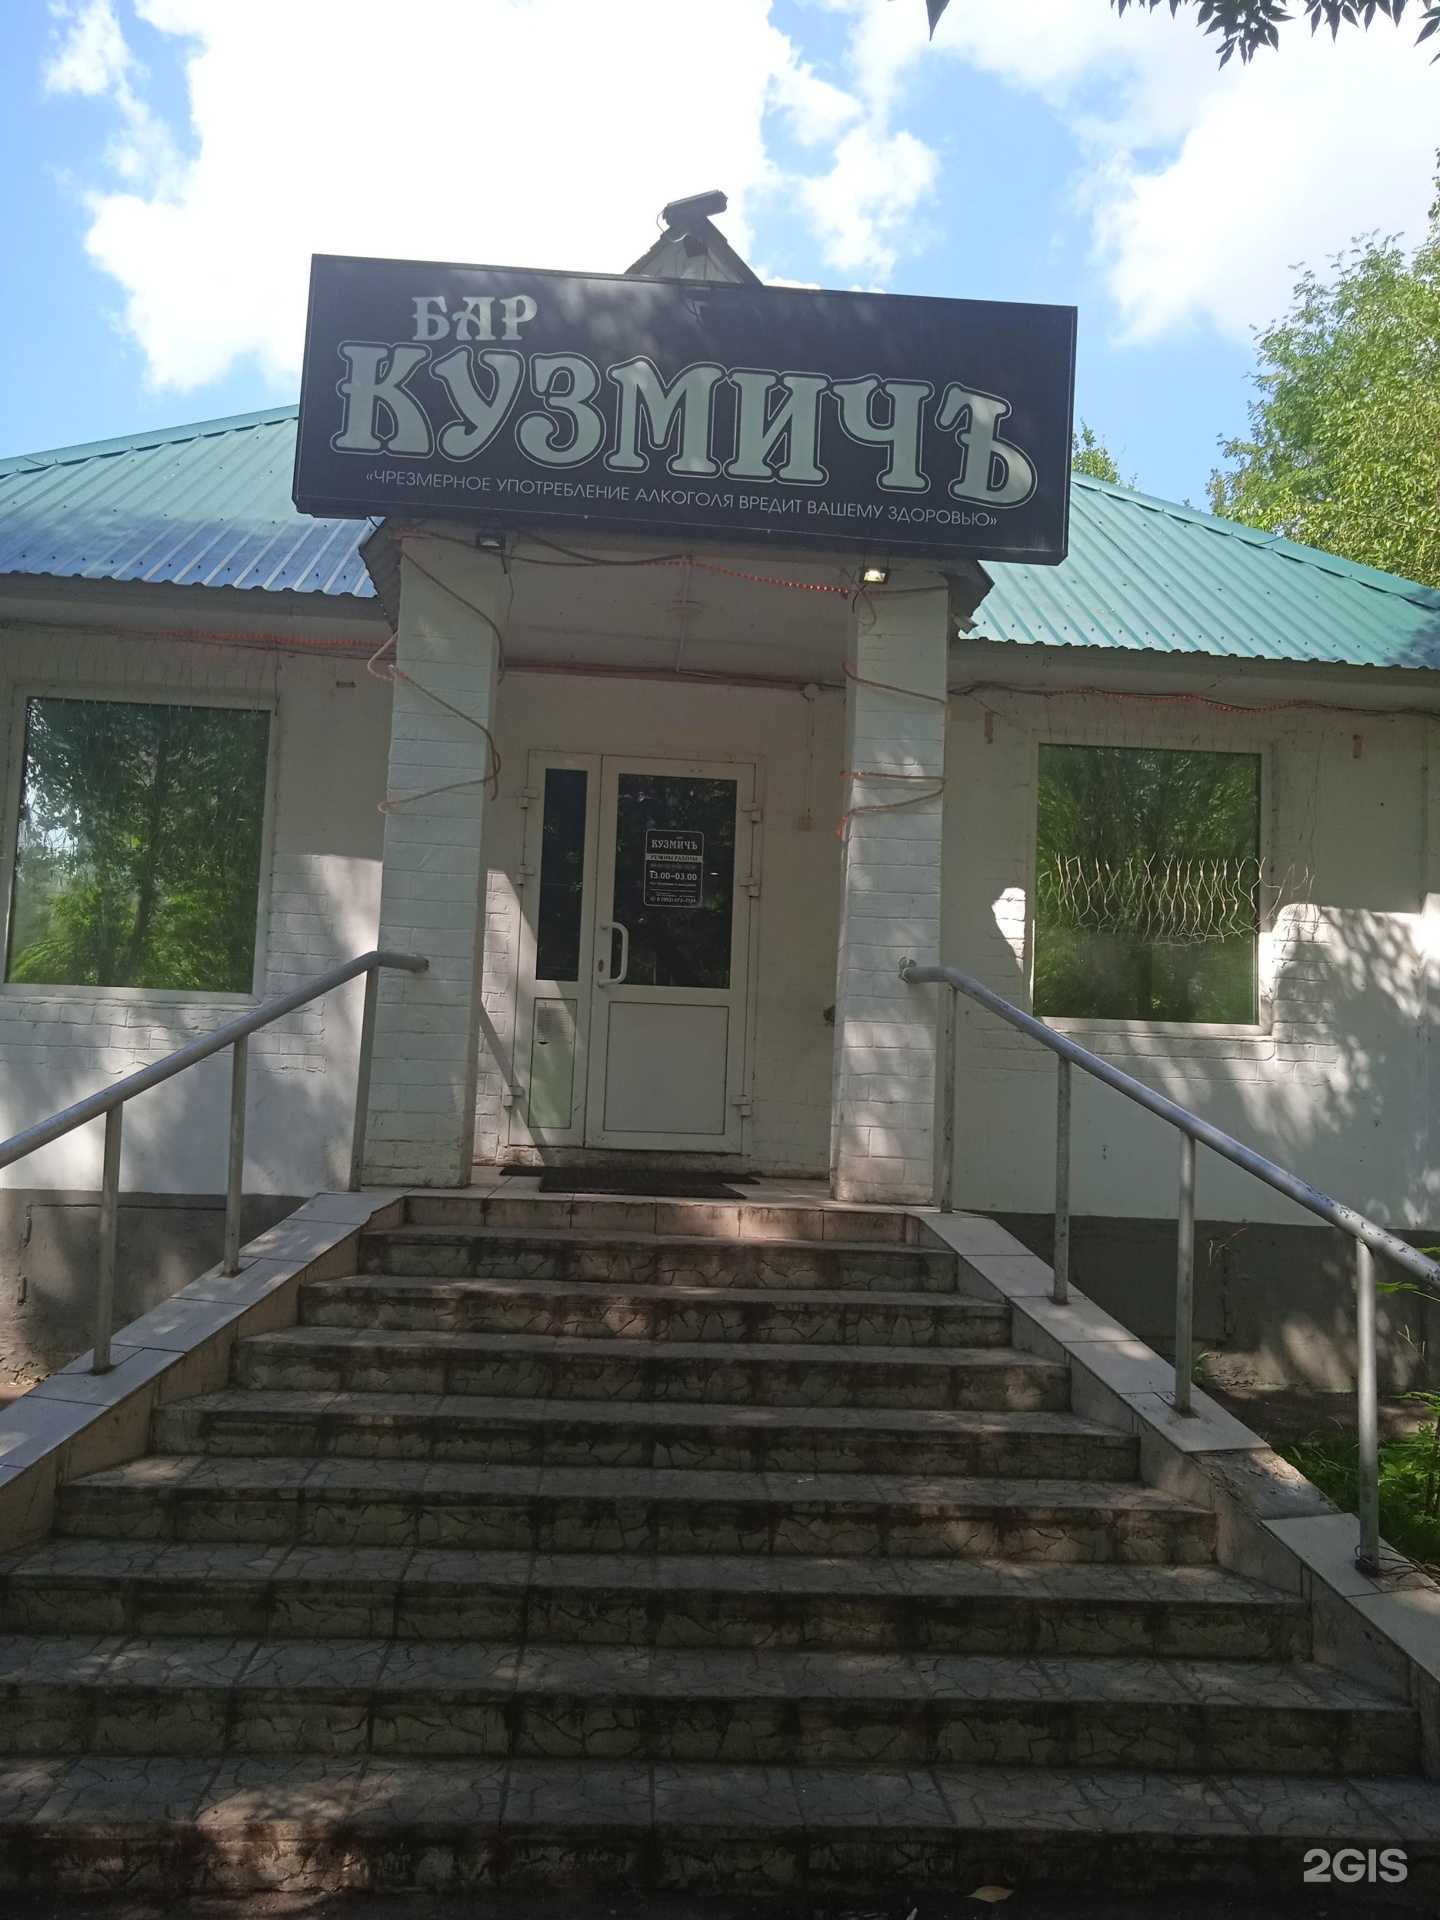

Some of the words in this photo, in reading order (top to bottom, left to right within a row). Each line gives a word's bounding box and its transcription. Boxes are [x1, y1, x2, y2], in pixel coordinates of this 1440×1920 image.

[411, 295, 538, 341] БАР
[330, 340, 1038, 509] КУЗМИЧЪ
[365, 470, 492, 492] «ЧРЕЗМЕРНОЕ
[496, 478, 630, 501] УПОТРЕБЛЕНИЕ
[635, 488, 734, 509] АЛКОГОЛЯ
[739, 495, 803, 515] ВРЕДИТ
[807, 501, 884, 519] ВАШЕМУ
[887, 505, 998, 527] ЗДОРОВЬЮ»
[651, 839, 698, 849] КУЗМИЧЪ
